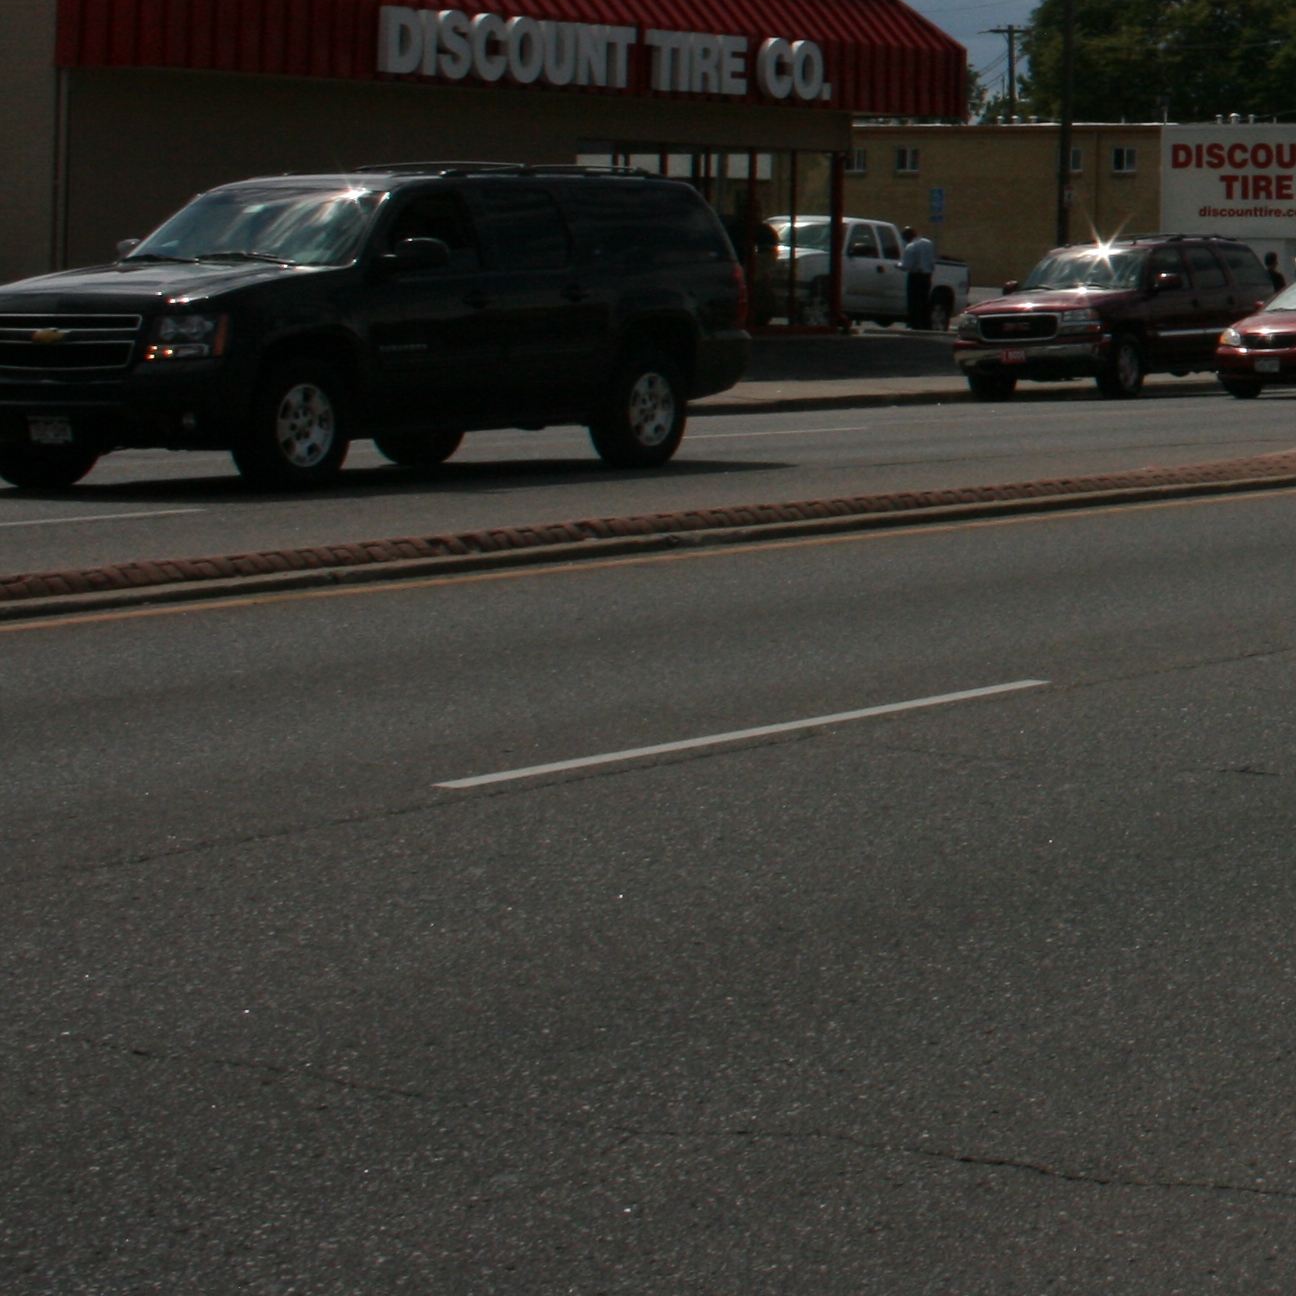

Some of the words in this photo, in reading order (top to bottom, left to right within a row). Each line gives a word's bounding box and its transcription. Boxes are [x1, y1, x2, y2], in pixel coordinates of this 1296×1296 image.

[377, 5, 637, 88] DISCOUNT
[644, 28, 748, 95] TIRE
[756, 37, 832, 100] CO.
[1220, 175, 1295, 200] TIRE
